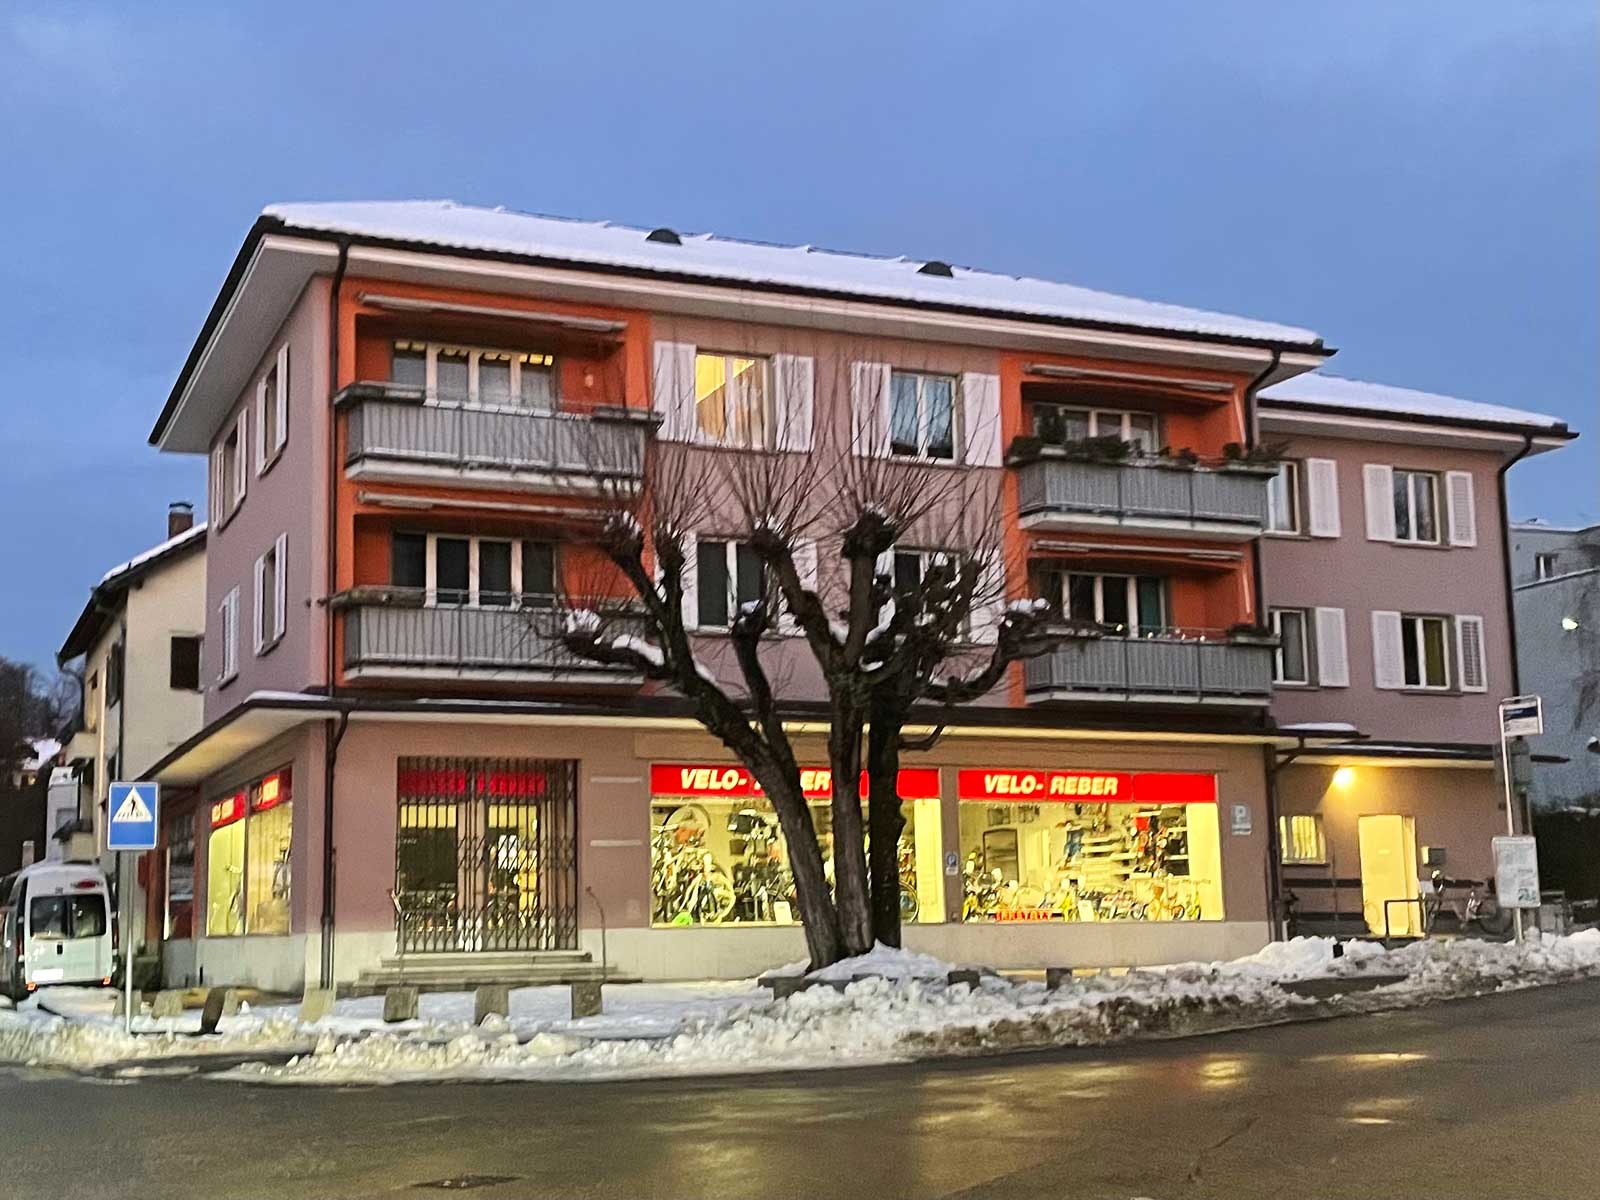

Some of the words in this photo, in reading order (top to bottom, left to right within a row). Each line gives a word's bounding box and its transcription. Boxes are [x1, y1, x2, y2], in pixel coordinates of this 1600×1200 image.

[681, 768, 747, 790] VELO-
[984, 774, 1044, 795] VELO-
[1050, 776, 1118, 796] REBER
